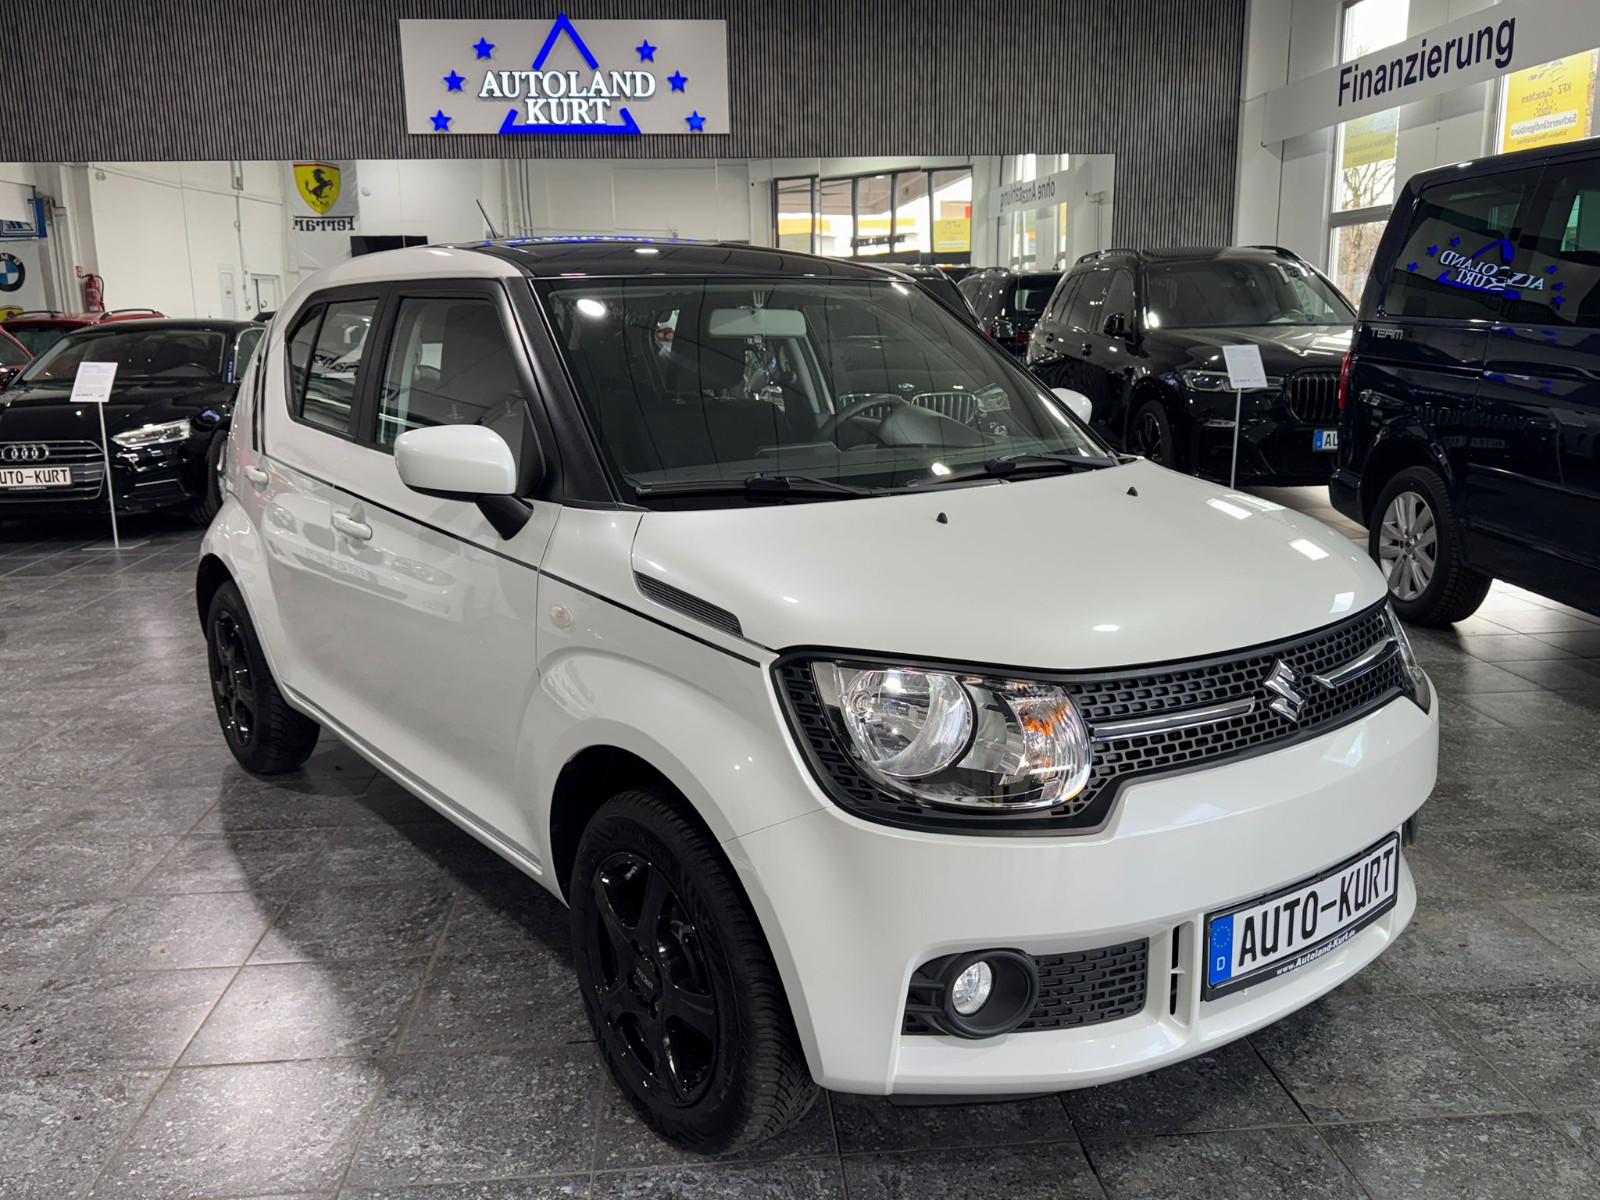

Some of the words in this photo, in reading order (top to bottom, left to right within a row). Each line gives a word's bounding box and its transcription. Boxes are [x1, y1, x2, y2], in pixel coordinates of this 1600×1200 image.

[1337, 16, 1516, 107] Finanzierung
[478, 70, 657, 99] AUTOLAND
[525, 98, 611, 125] KURT
[0, 470, 68, 485] UTO-KURT
[1238, 846, 1394, 967] AUTO-KURT
[1216, 956, 1226, 971] D
[1276, 929, 1356, 975] www.Autoland-Kurt.de
